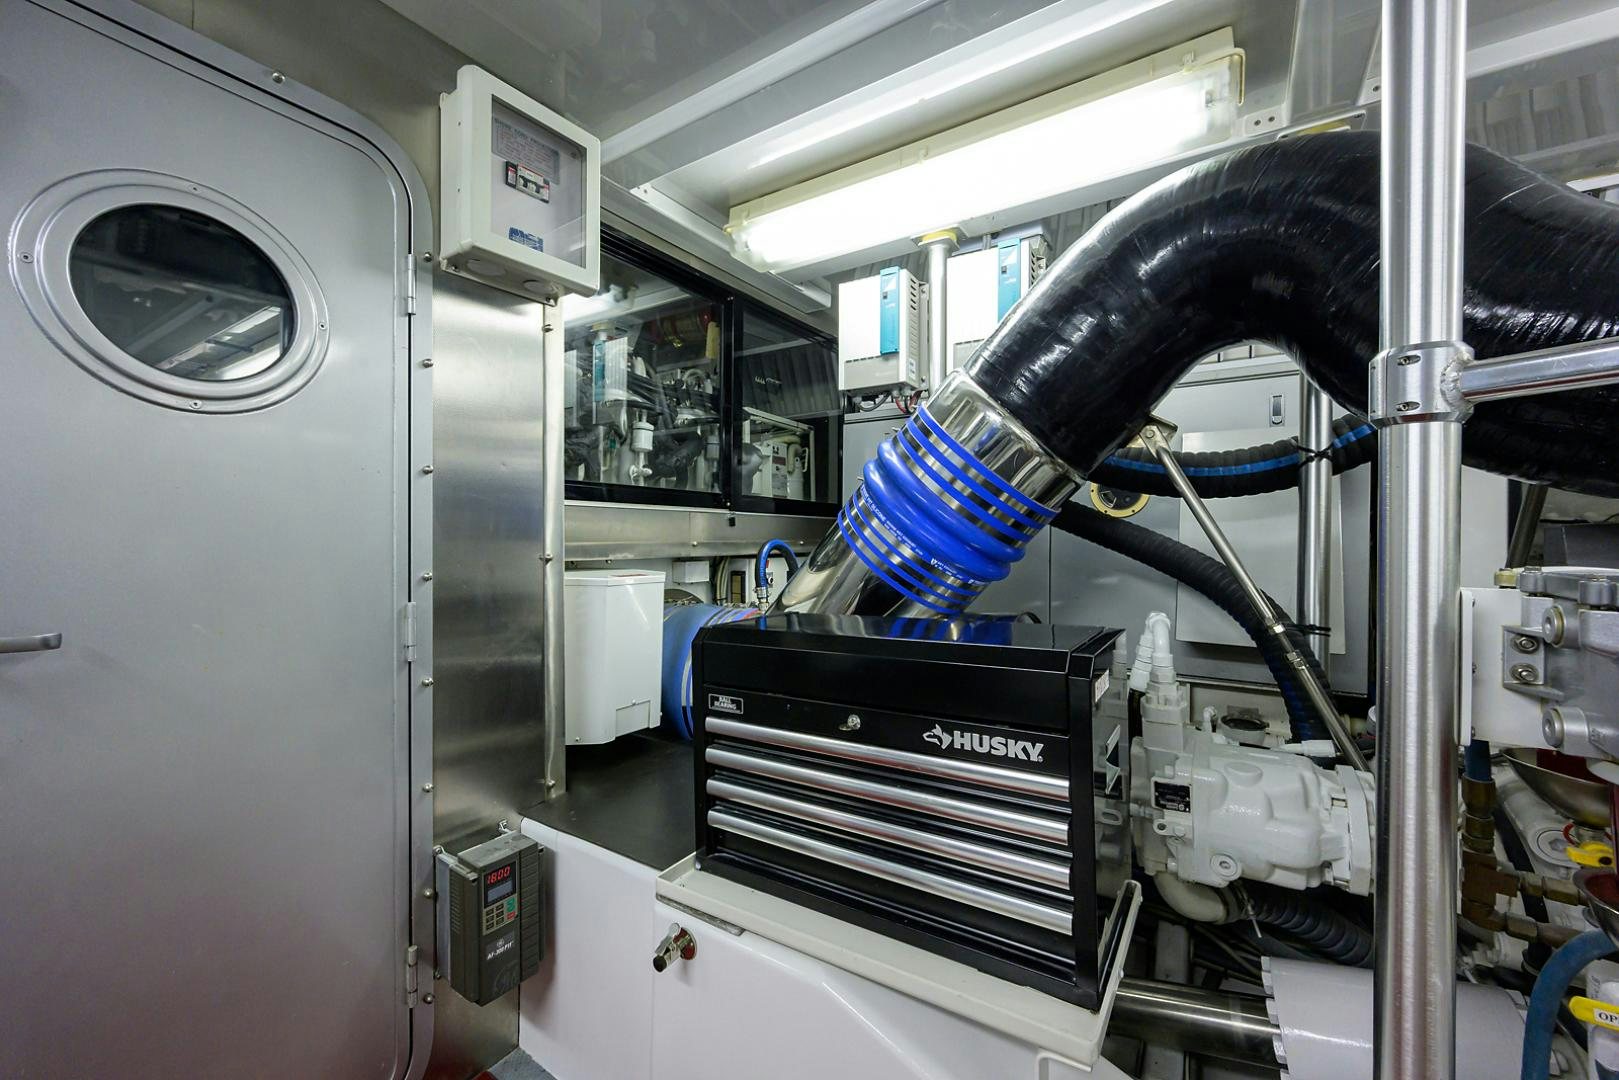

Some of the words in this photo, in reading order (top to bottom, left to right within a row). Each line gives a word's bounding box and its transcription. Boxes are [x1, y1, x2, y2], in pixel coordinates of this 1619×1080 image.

[953, 730, 1045, 762] HUSKY
[487, 864, 512, 885] 1800
[1598, 1011, 1619, 1024] OP
